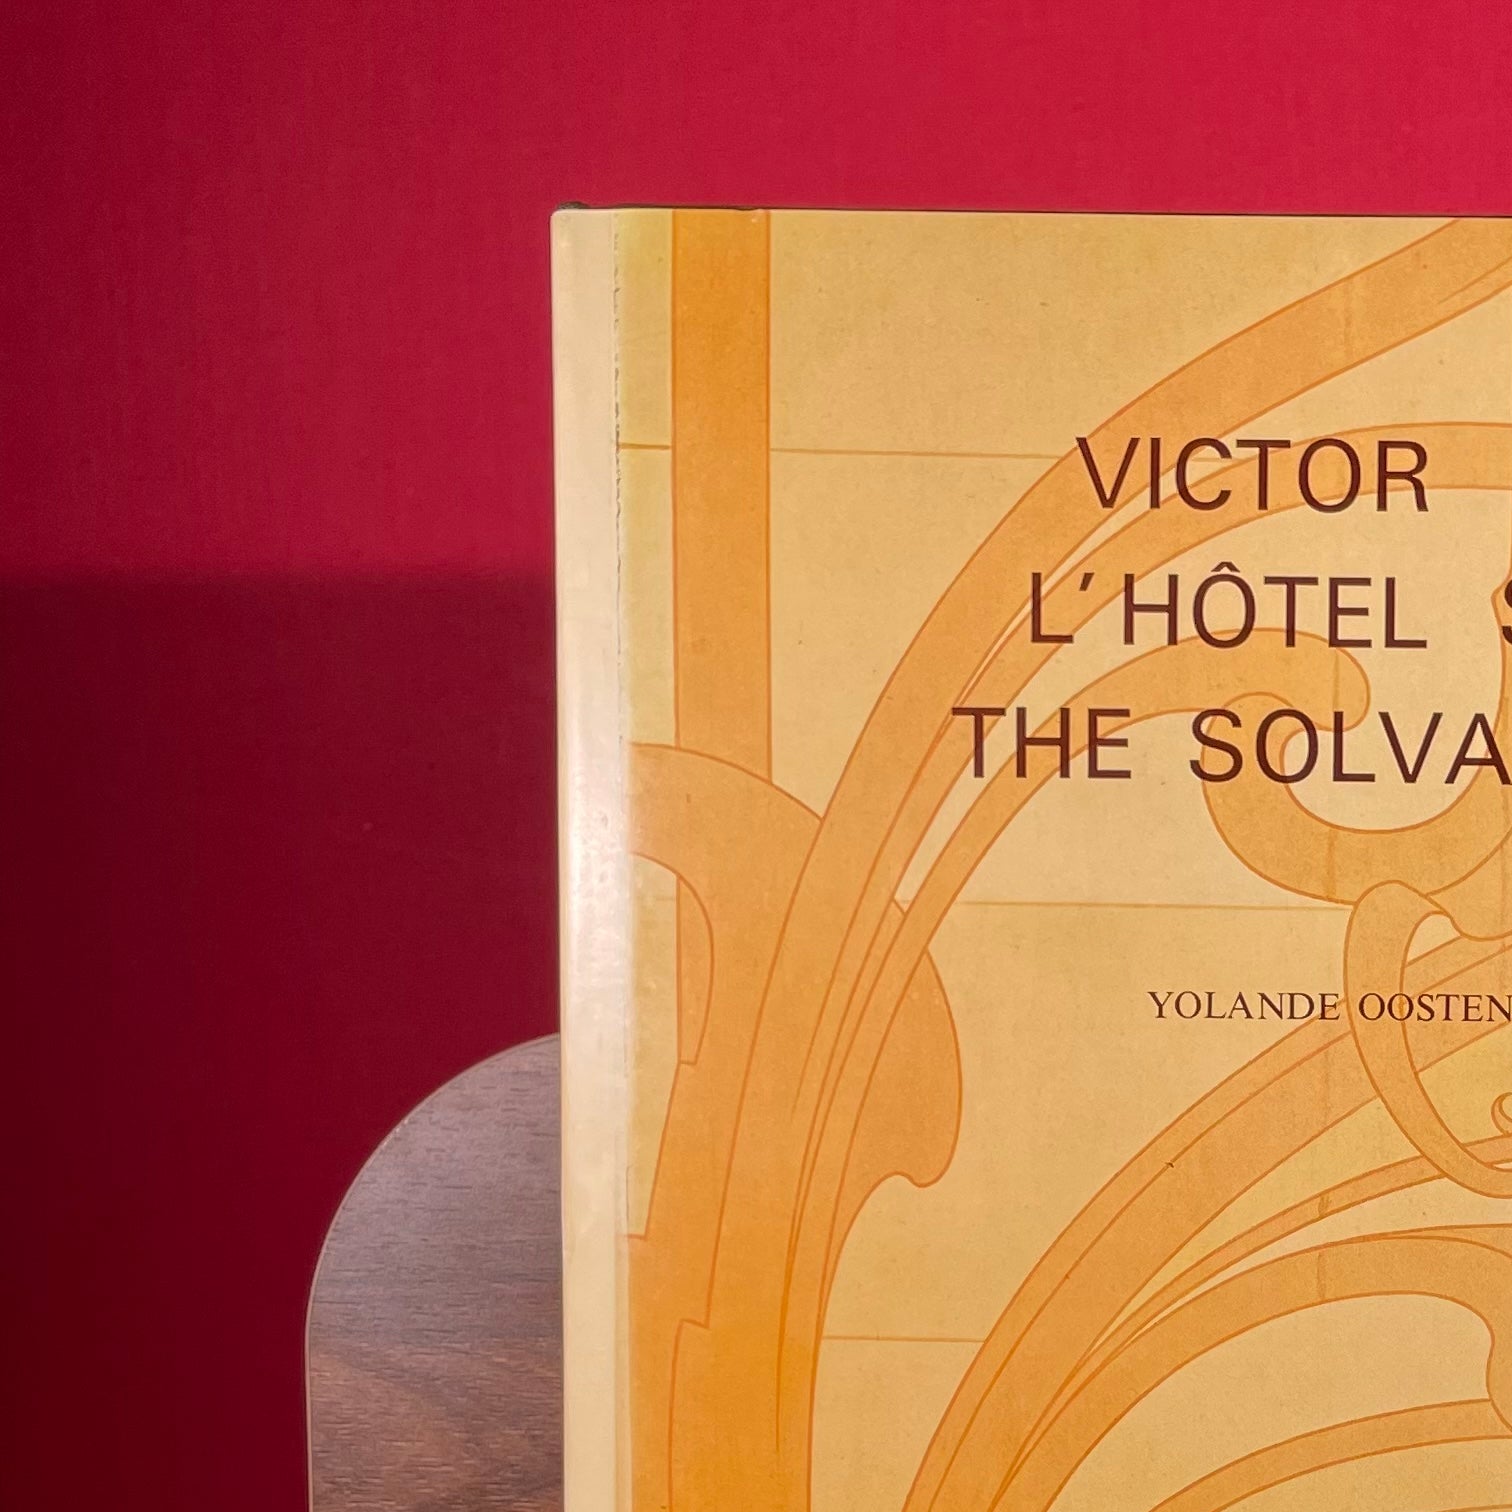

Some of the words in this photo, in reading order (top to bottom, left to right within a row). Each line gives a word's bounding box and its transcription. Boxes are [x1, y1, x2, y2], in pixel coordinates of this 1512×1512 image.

[1075, 437, 1429, 513] VICTOR
[951, 706, 1132, 779] THE
[1147, 990, 1340, 1021] YOLANDE
